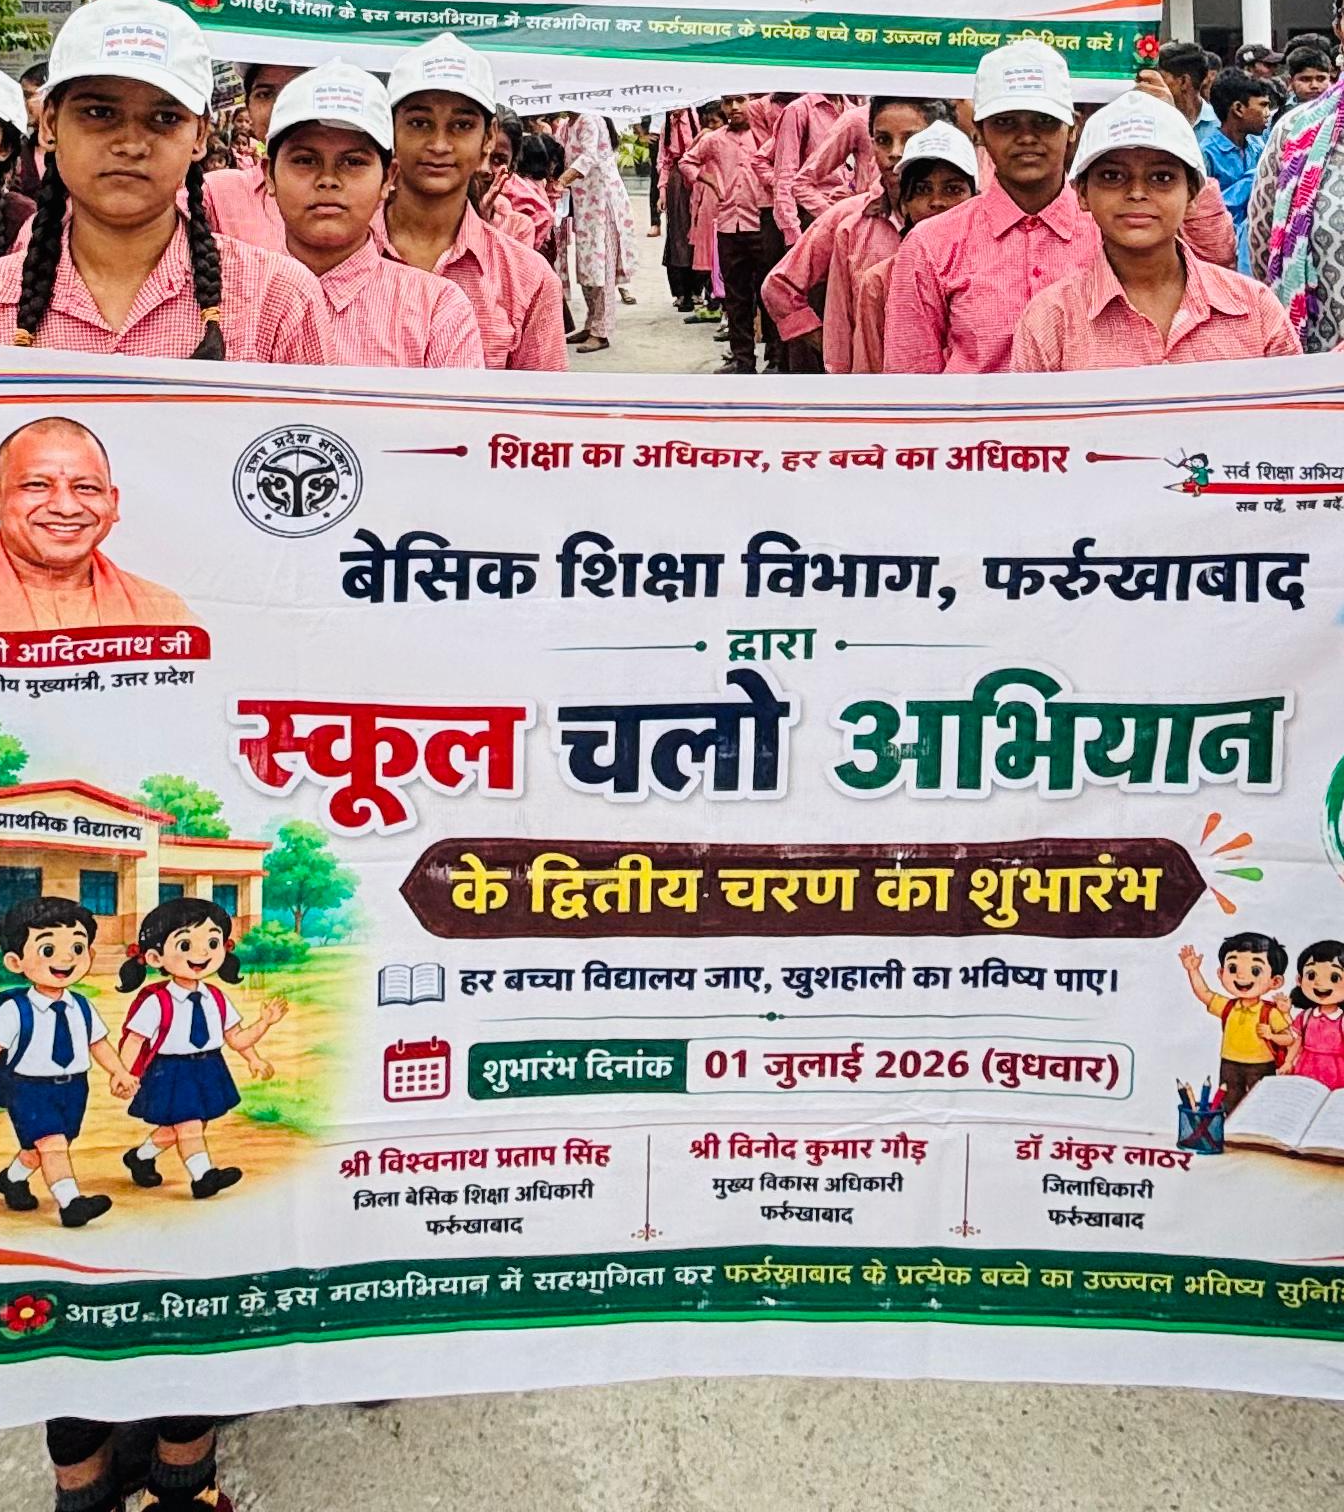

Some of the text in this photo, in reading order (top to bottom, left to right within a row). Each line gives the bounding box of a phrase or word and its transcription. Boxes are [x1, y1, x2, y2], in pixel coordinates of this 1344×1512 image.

[489, 434, 1070, 473] शिक्षा का अधिकार, हर बच्चे का अधिकार
[1223, 461, 1250, 480] सर्व
[1256, 461, 1293, 481] शिक्षा
[340, 528, 540, 603] बेसिक
[557, 530, 725, 602] शिक्षा
[741, 530, 956, 611] विभाग,
[17, 632, 153, 663] आदित्यनाथ
[160, 630, 192, 656] जी
[727, 628, 816, 661] द्वारा
[25, 670, 105, 699] मुख्यमंत्री,
[111, 671, 147, 688] उत्तर
[154, 666, 194, 687] प्रदेश
[238, 667, 1286, 828] स्कूल चलो अभियान
[73, 816, 143, 840] विद्यालय
[450, 852, 1163, 929] के द्वितीय चरण का शुभारंभ
[460, 958, 1117, 999] हर बच्चा विद्यालय जाए, खुशहाली का भविष्य पाए।
[482, 1042, 1121, 1093] शुभारंभ दिनांक 01 जुलाई 2026 (बुधवार)
[339, 1137, 612, 1179] श्री विश्वनाथ प्रताप सिंह
[690, 1131, 928, 1167] श्री विनोद कुमार गौड़
[1015, 1133, 1193, 1171] डॉ अंकुर लाठर
[353, 1178, 594, 1211] जिला बेसिक शिक्षा अधिकारी
[712, 1171, 904, 1198] मुख्य विकास अधिकारी
[1043, 1174, 1155, 1200] जिलाधिकारी
